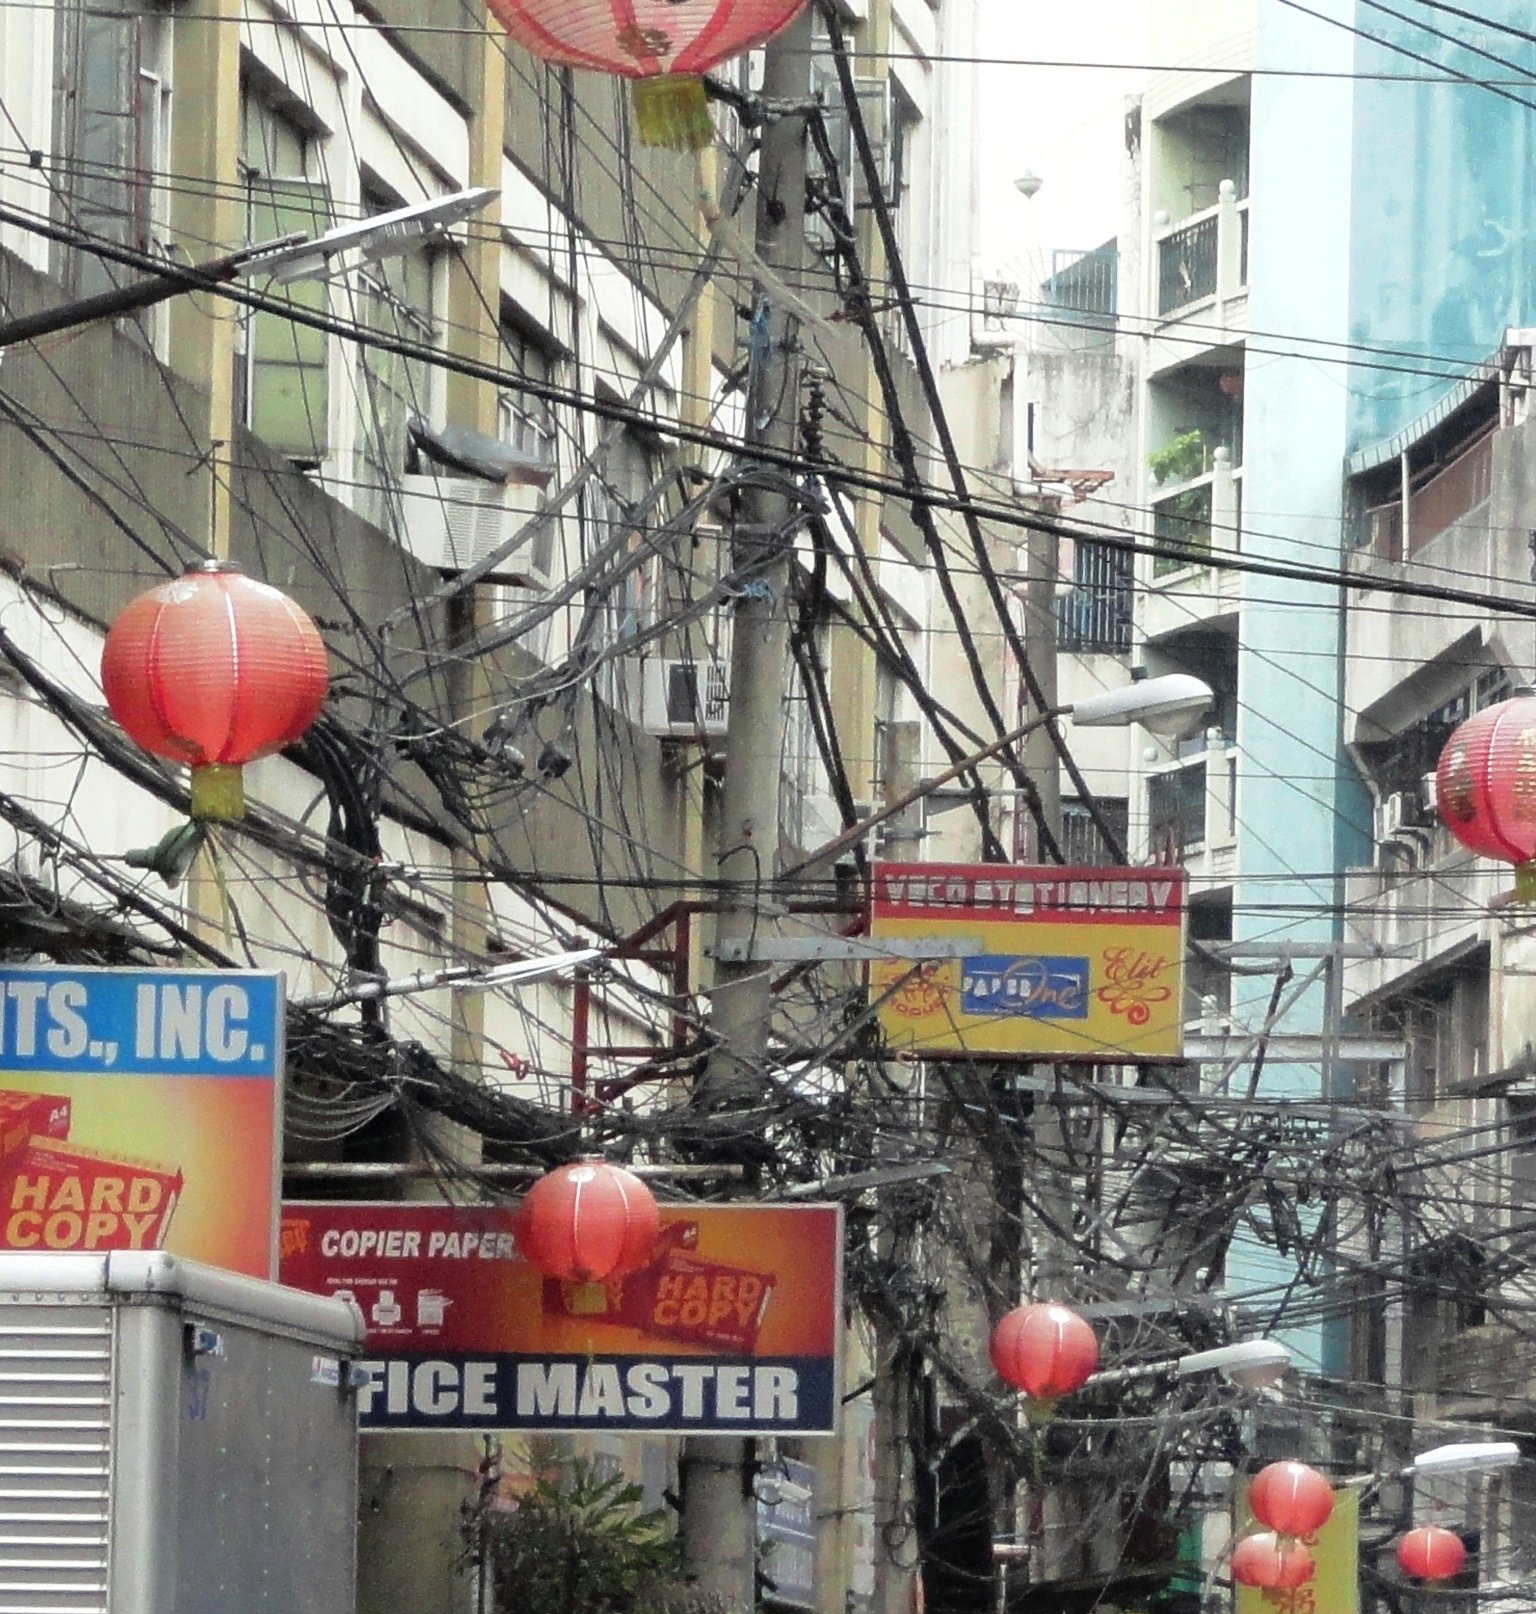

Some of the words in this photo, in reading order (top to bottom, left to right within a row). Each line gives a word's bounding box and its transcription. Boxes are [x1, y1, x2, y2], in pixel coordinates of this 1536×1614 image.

[136, 984, 265, 1062] INC.
[10, 1174, 163, 1212] HARD
[5, 1211, 159, 1249] COPY
[321, 1229, 421, 1259] COPIER
[427, 1230, 516, 1260] PAPER
[656, 1274, 760, 1303] HARD
[654, 1300, 757, 1326] COPY
[515, 1362, 799, 1420] MASTER
